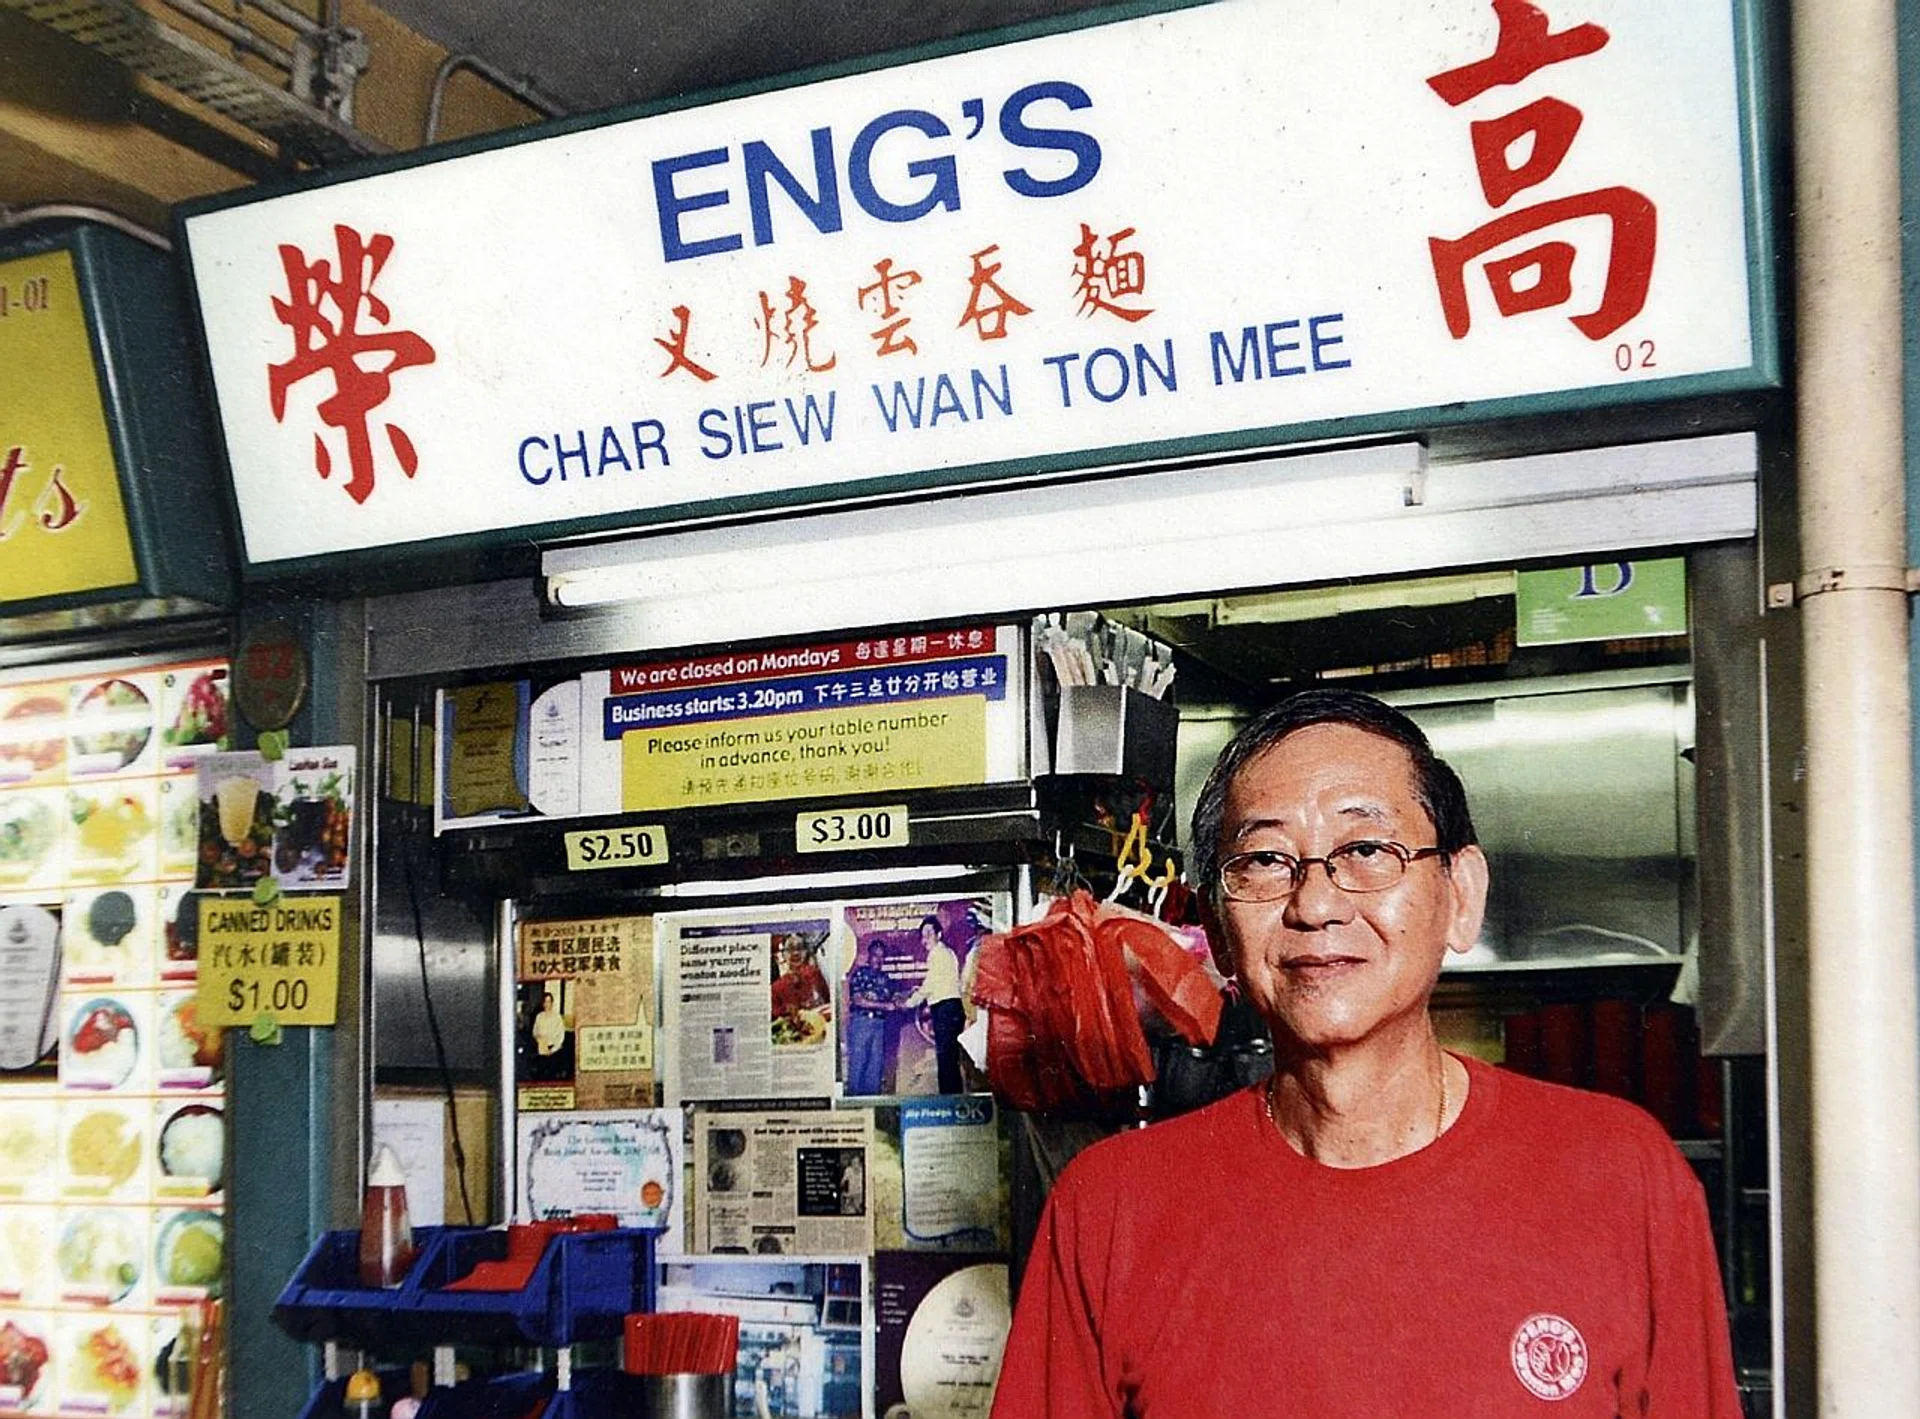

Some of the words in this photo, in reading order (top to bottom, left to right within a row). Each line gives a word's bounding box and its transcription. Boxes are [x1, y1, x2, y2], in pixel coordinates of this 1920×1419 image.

[652, 82, 1103, 262] ENG'S
[1427, 0, 1657, 342] 高
[268, 224, 436, 505] 榮
[1615, 340, 1656, 371] 02
[518, 419, 669, 486] CHAR
[699, 391, 836, 460] SIEW
[872, 365, 1013, 432] WAN
[1043, 339, 1178, 408] TON
[1210, 313, 1352, 385] MEE
[620, 669, 647, 687] We
[650, 668, 678, 684] are
[681, 657, 734, 680] closed
[737, 657, 759, 674] on
[761, 646, 840, 671] Mondays
[612, 702, 684, 723] Business
[685, 695, 735, 715] starts:
[737, 688, 804, 711] 3.20pm
[648, 736, 702, 755] Please
[705, 729, 760, 749] inform
[764, 728, 783, 744] us
[787, 724, 826, 744] your
[830, 718, 874, 739] table
[877, 712, 948, 732] number
[700, 755, 715, 770] in
[719, 748, 796, 768] advance,
[799, 742, 848, 760] thank
[851, 737, 890, 757] you!
[811, 812, 891, 843] $3.00
[579, 832, 652, 863] $2.50
[207, 908, 270, 934] CANNED
[275, 907, 332, 932] DRINKS
[680, 943, 727, 956] Different
[710, 956, 752, 970] yummy
[719, 964, 761, 978] noodles
[228, 978, 309, 1012] $1.00
